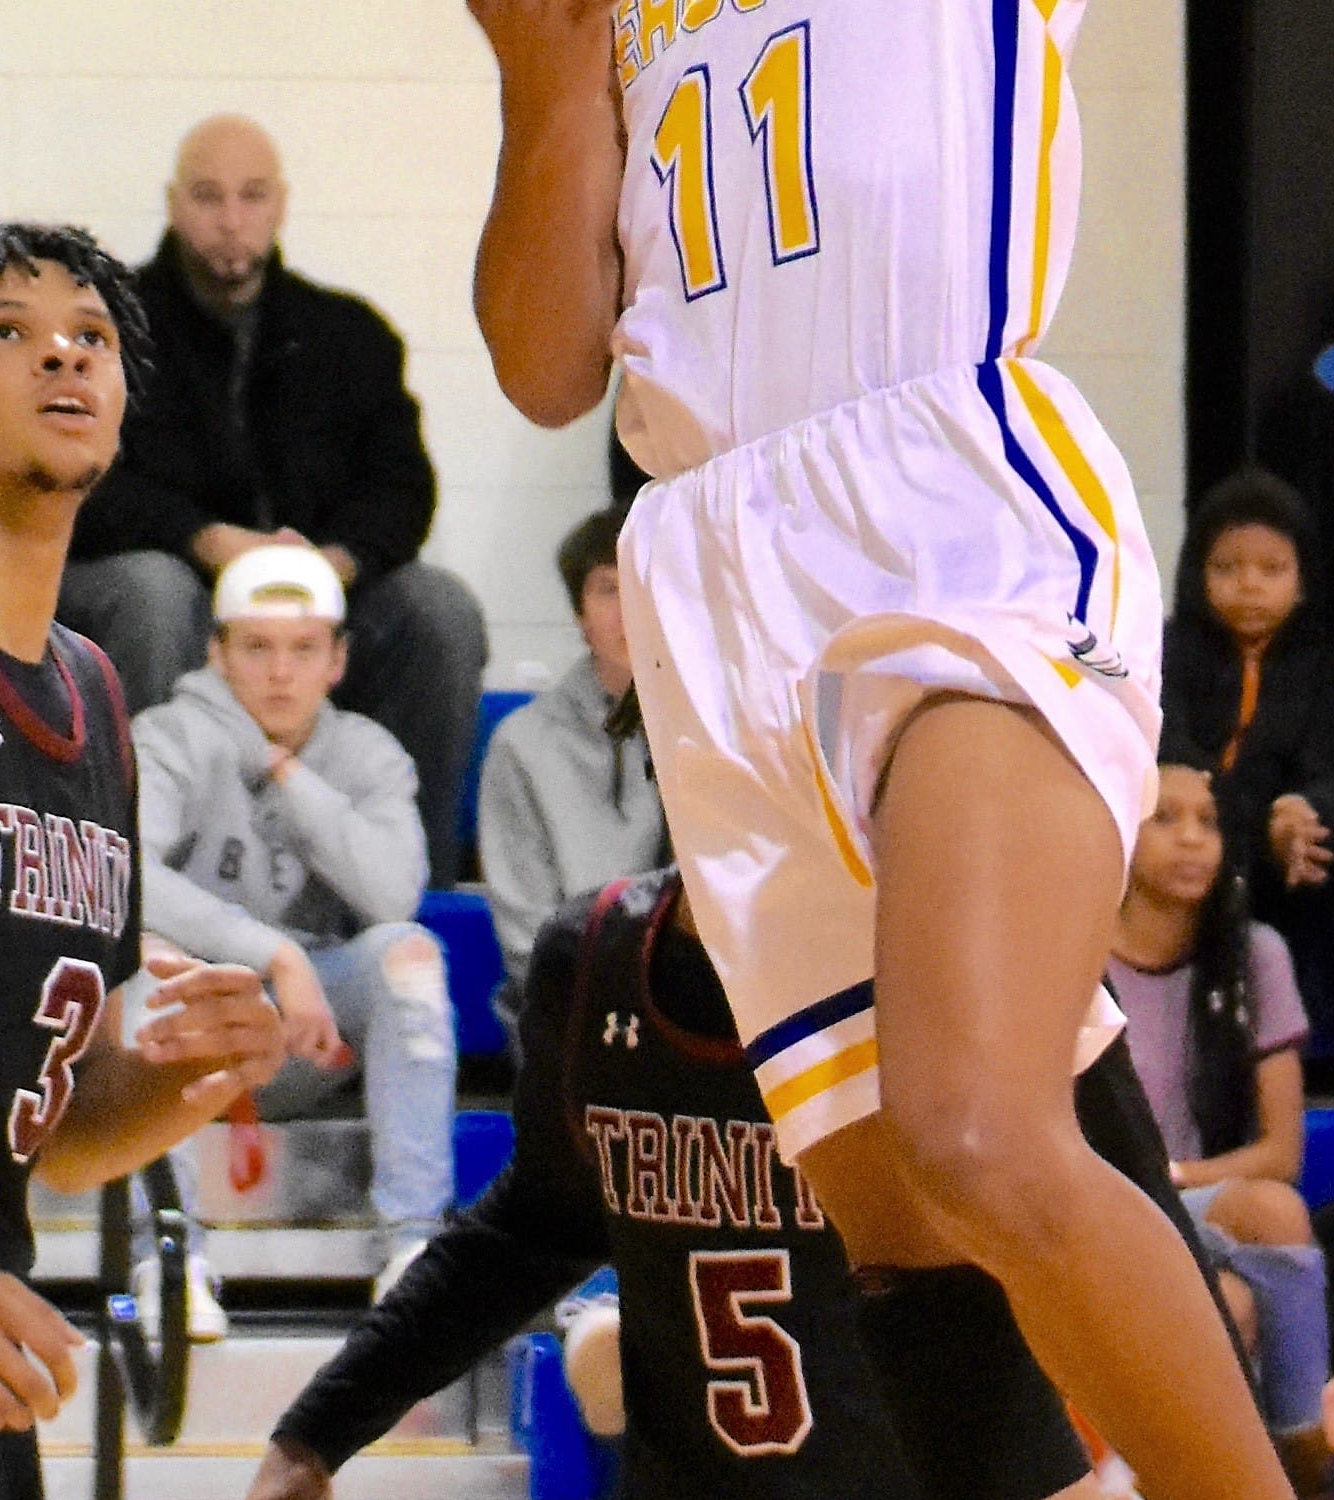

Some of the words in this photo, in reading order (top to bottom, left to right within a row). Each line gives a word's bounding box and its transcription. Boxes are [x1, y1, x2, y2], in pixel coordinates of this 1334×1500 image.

[650, 18, 820, 303] 11
[7, 955, 107, 1164] 3
[689, 1247, 814, 1458] 5
